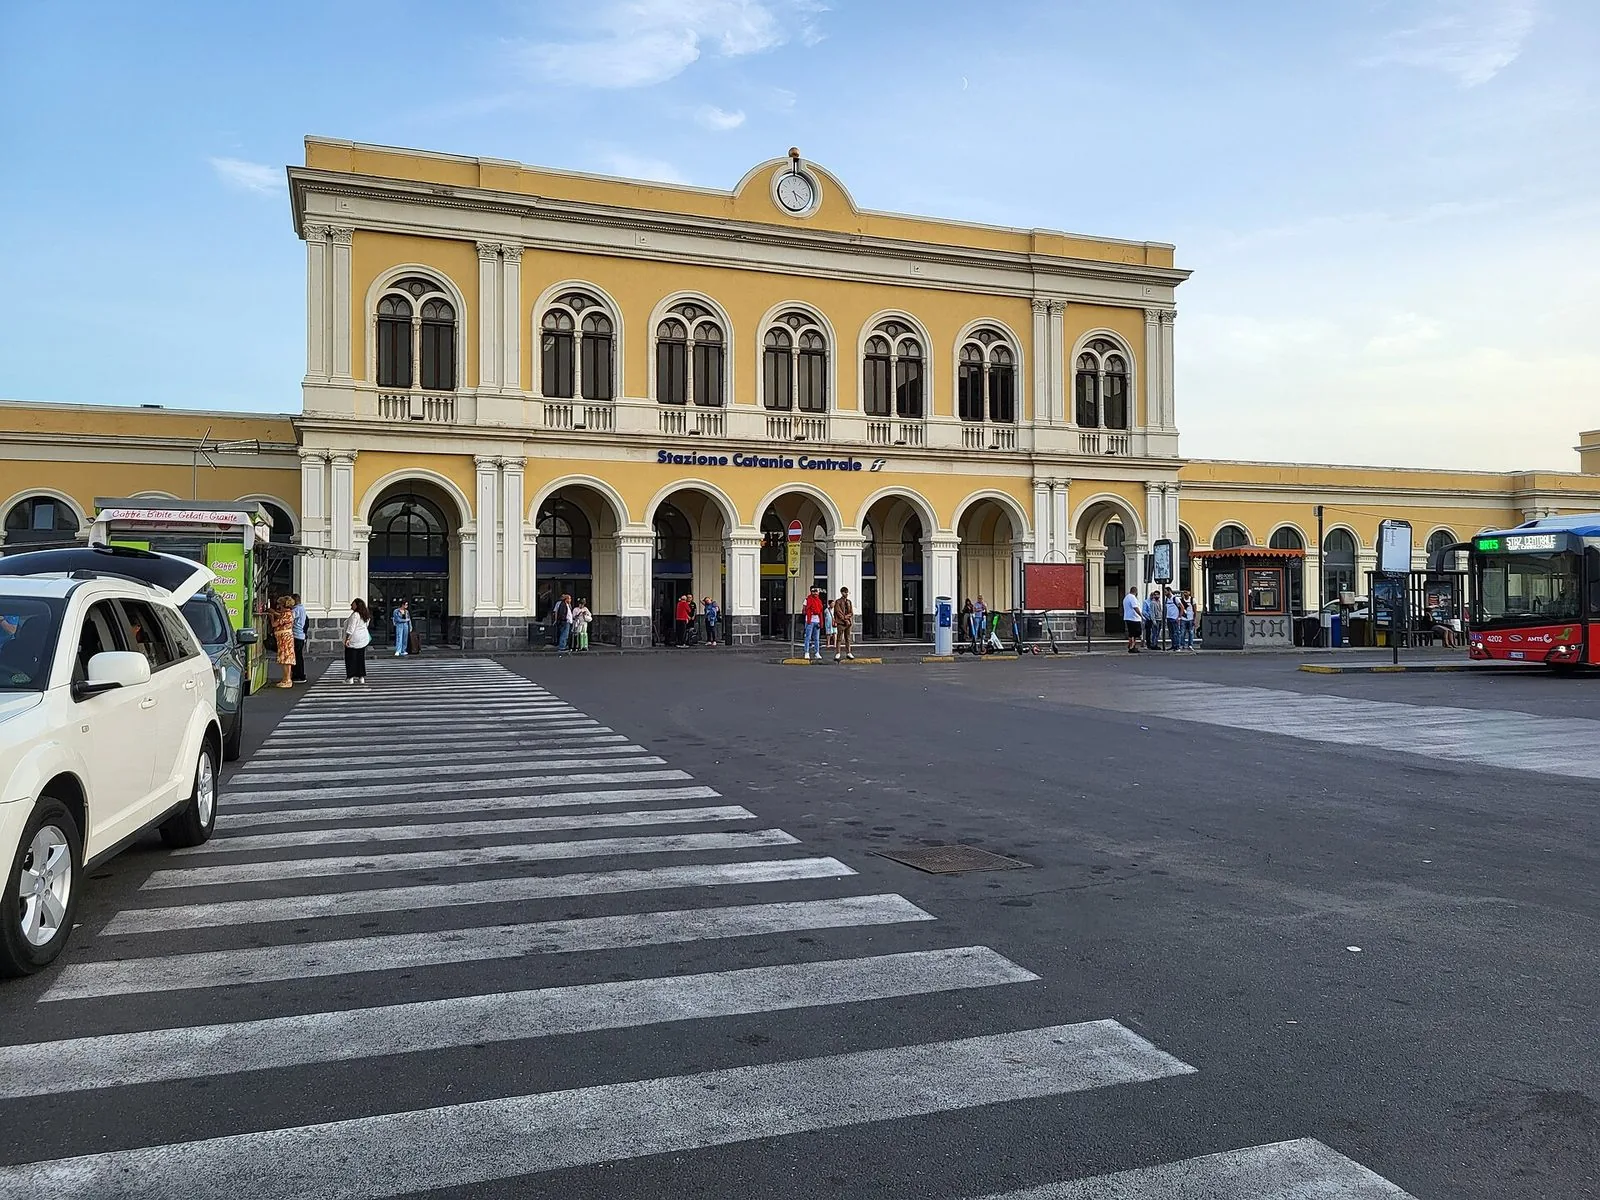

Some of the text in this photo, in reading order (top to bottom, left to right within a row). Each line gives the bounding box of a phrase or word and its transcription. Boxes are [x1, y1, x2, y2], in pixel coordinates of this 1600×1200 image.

[657, 449, 862, 472] Stazione Catania Centrale
[146, 509, 172, 519] Bibite
[179, 511, 204, 520] Gelati
[209, 512, 238, 521] Granite
[1524, 535, 1557, 545] CENTRALE
[1486, 635, 1503, 643] 4202
